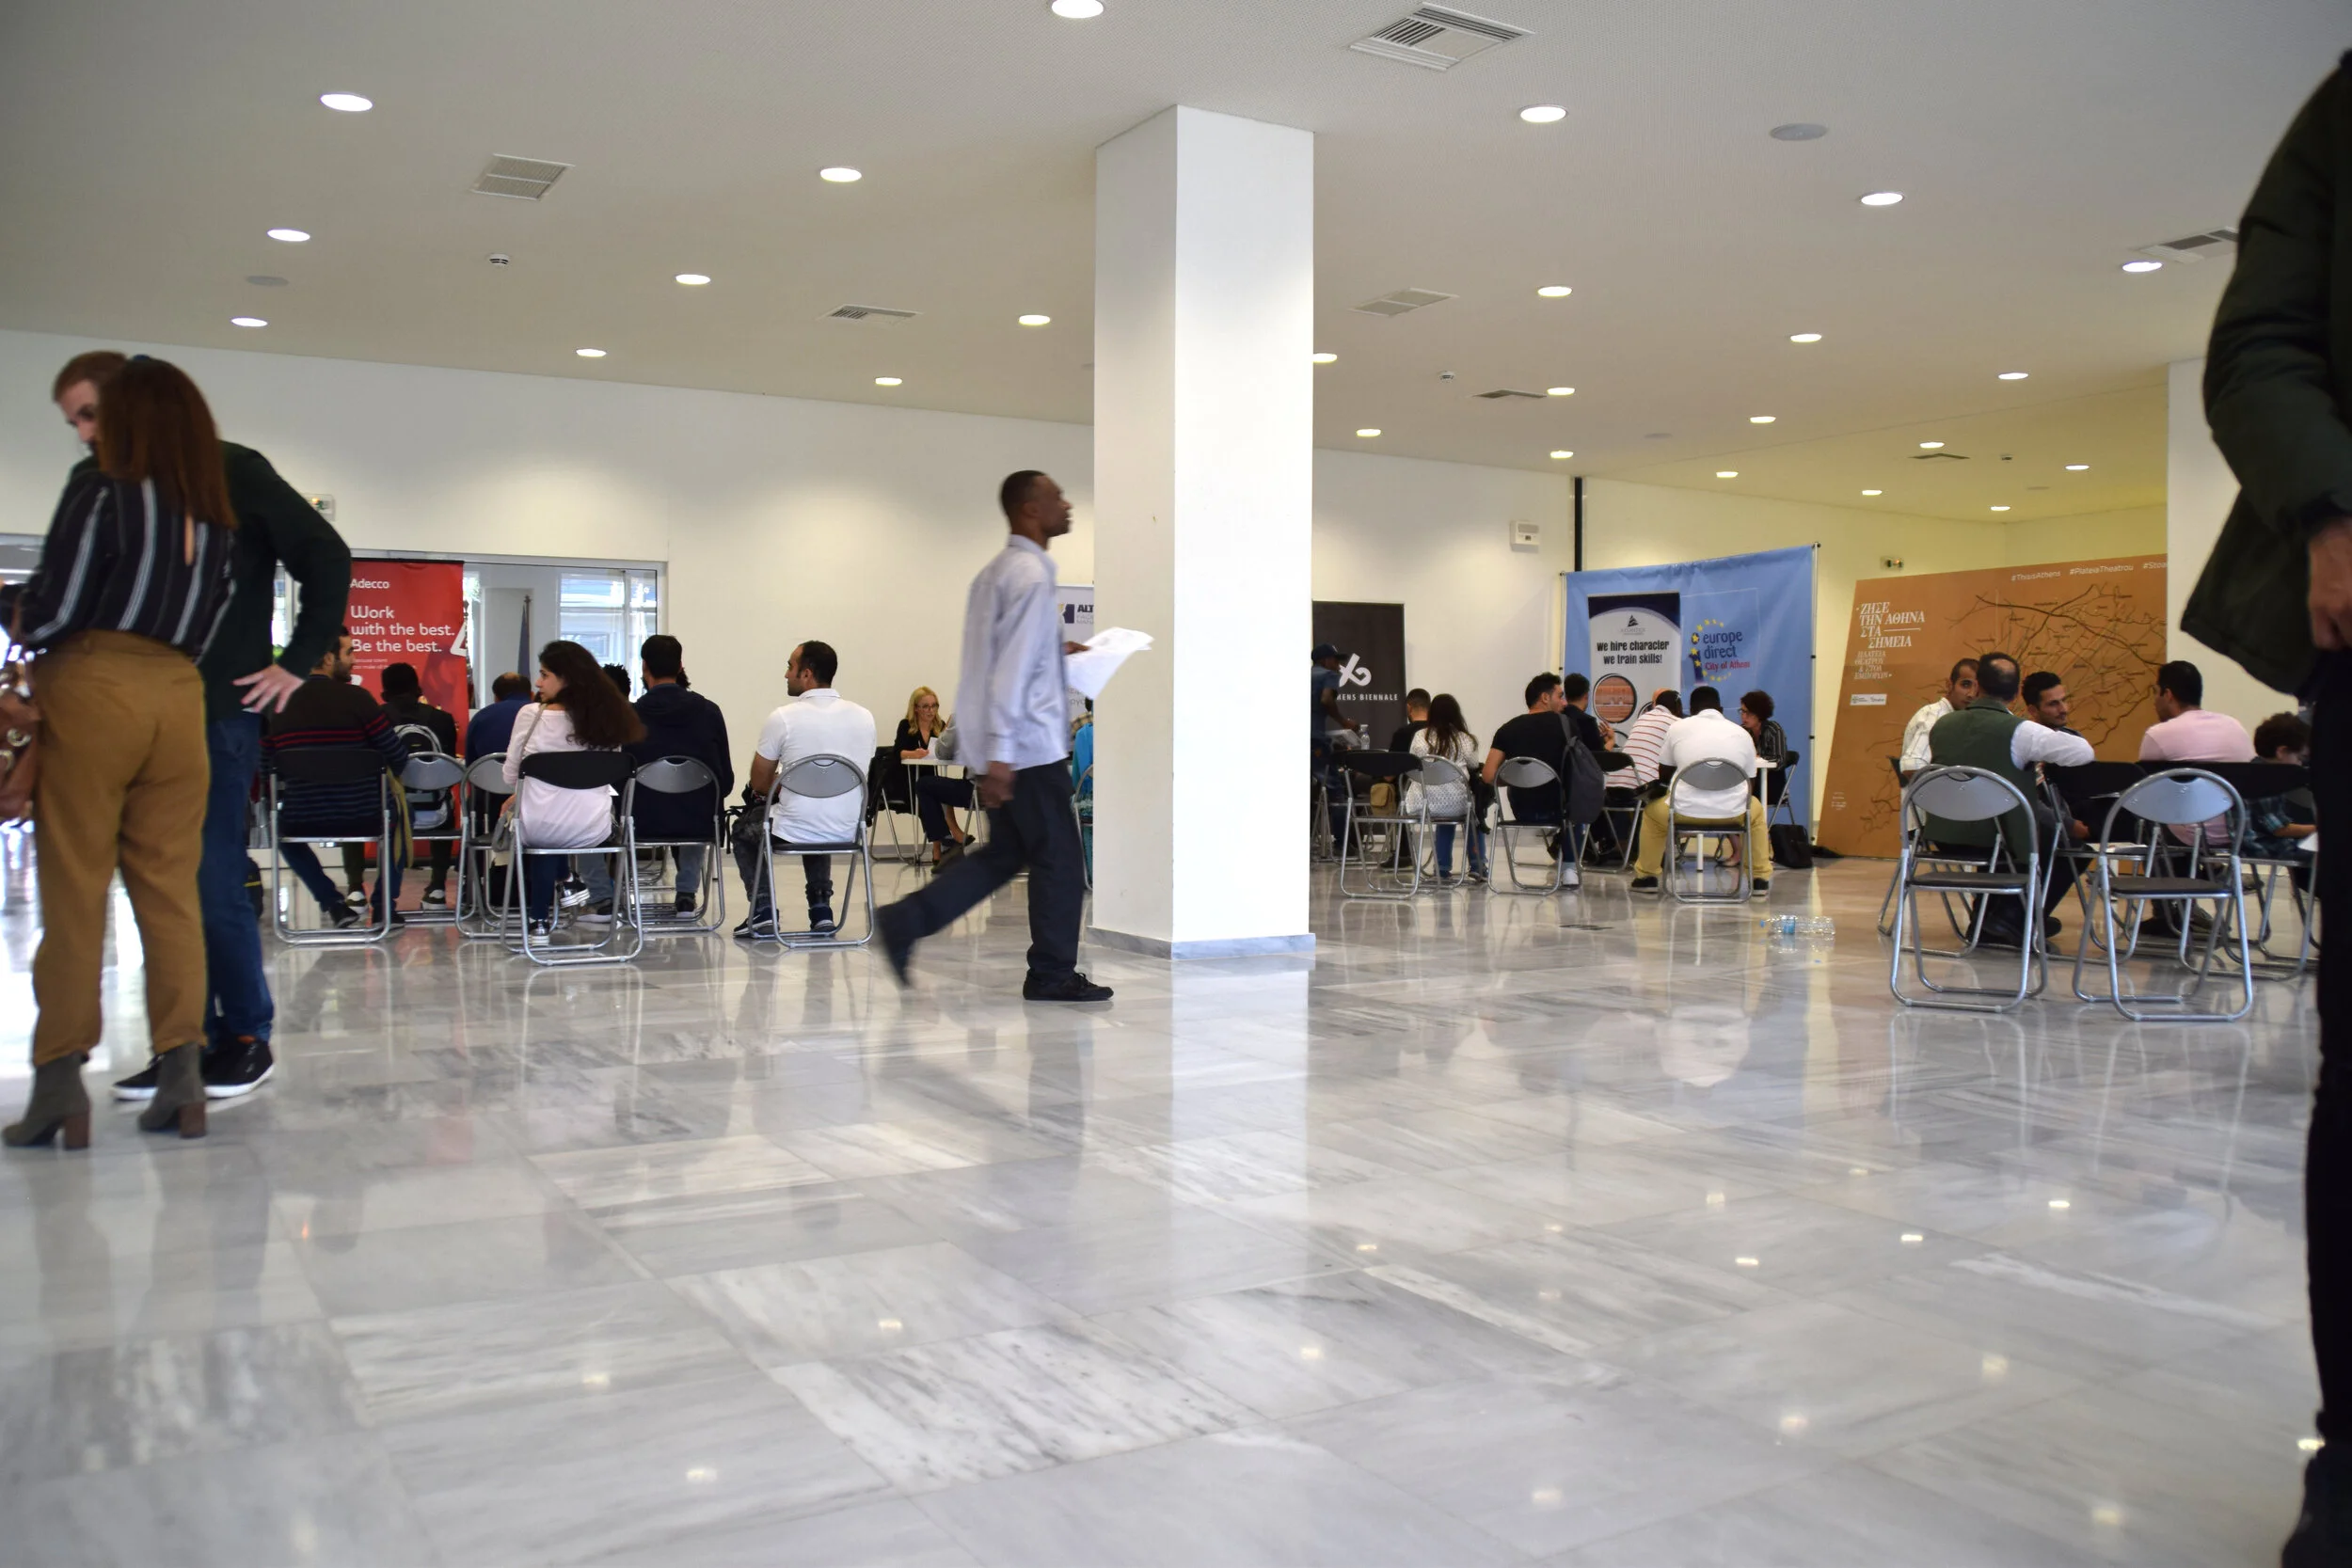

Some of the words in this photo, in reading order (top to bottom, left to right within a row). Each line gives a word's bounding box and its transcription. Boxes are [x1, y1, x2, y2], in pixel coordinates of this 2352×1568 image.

[350, 578, 390, 589] Adecco
[350, 605, 395, 619] Work
[1077, 604, 1094, 613] ALT
[1861, 602, 1890, 614] ΖΗΣΕ
[1884, 611, 1926, 625] ΑΘΗΝΑ
[351, 621, 385, 636] with
[389, 622, 415, 636] the
[419, 623, 455, 636] best.
[1703, 631, 1743, 646] europe
[351, 639, 372, 653] Be
[376, 640, 402, 653] the
[406, 639, 443, 653] best.
[1597, 641, 1608, 652] we
[1610, 641, 1628, 651] hire
[1629, 640, 1670, 651] character
[1704, 645, 1738, 659] direct
[1603, 655, 1615, 664] we
[1617, 654, 1637, 664] train
[1639, 653, 1663, 664] skills!
[1705, 661, 1719, 673] City
